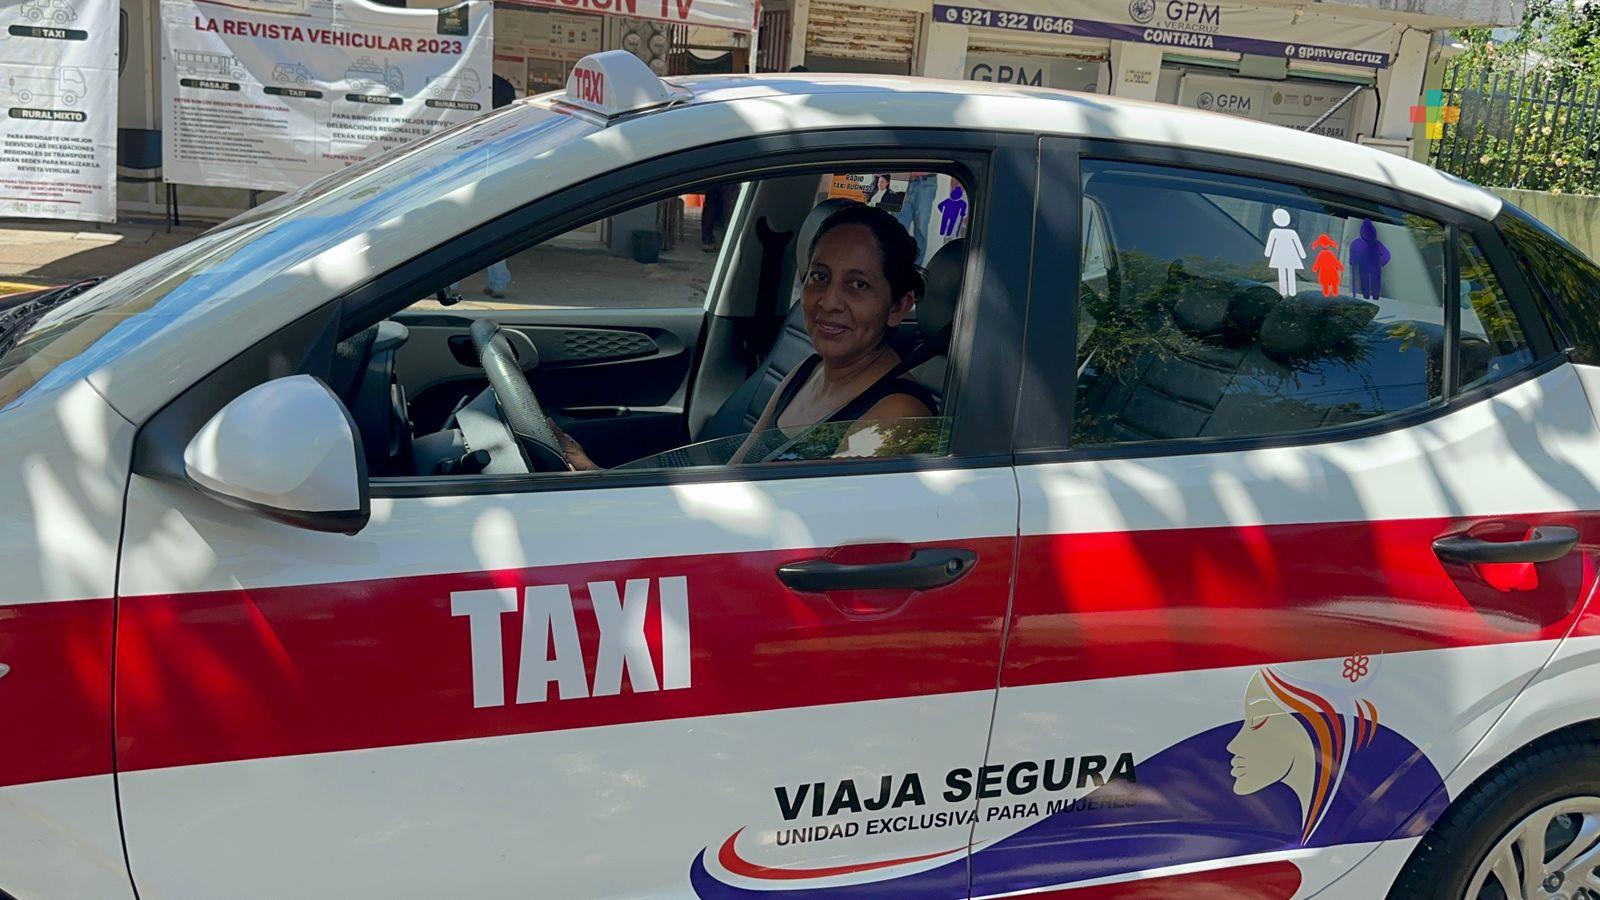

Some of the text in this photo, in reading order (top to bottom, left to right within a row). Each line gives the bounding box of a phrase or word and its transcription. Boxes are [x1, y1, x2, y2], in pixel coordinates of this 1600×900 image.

[1166, 0, 1220, 25] GPM
[961, 9, 1073, 34] 921 322 0646
[1164, 21, 1219, 33] VERACRUZ
[42, 29, 66, 38] TAXI
[195, 16, 462, 54] LA REVISTA VEHICULAR 2023
[1143, 28, 1213, 48] CONTRATA
[1298, 45, 1382, 64] gpmveracruz
[970, 63, 1042, 87] GPM
[200, 81, 229, 90] PASAJE
[575, 68, 604, 105] TAXI
[287, 89, 306, 97] TAXI
[367, 96, 390, 104] CARGA
[434, 100, 479, 110] RURAL MIXTO
[1217, 94, 1251, 110] GPM
[22, 110, 83, 120] RURAL MIXTO
[351, 114, 389, 122] BRINDARTE
[326, 122, 377, 131] DELEGACIONES
[379, 126, 420, 135] REGIONALES
[1327, 128, 1345, 137] PARA
[48, 144, 95, 152] DELEGACIONES
[54, 152, 95, 160] TRANSPORTE
[845, 174, 864, 183] RADIO
[846, 184, 872, 192] BUSINESS
[450, 575, 691, 708] TAXI
[774, 752, 1138, 821] VIAJA SEGURA
[776, 822, 859, 846] UNIDAD
[865, 809, 979, 835] EXCLUSIVA
[986, 804, 1039, 822] PARA
